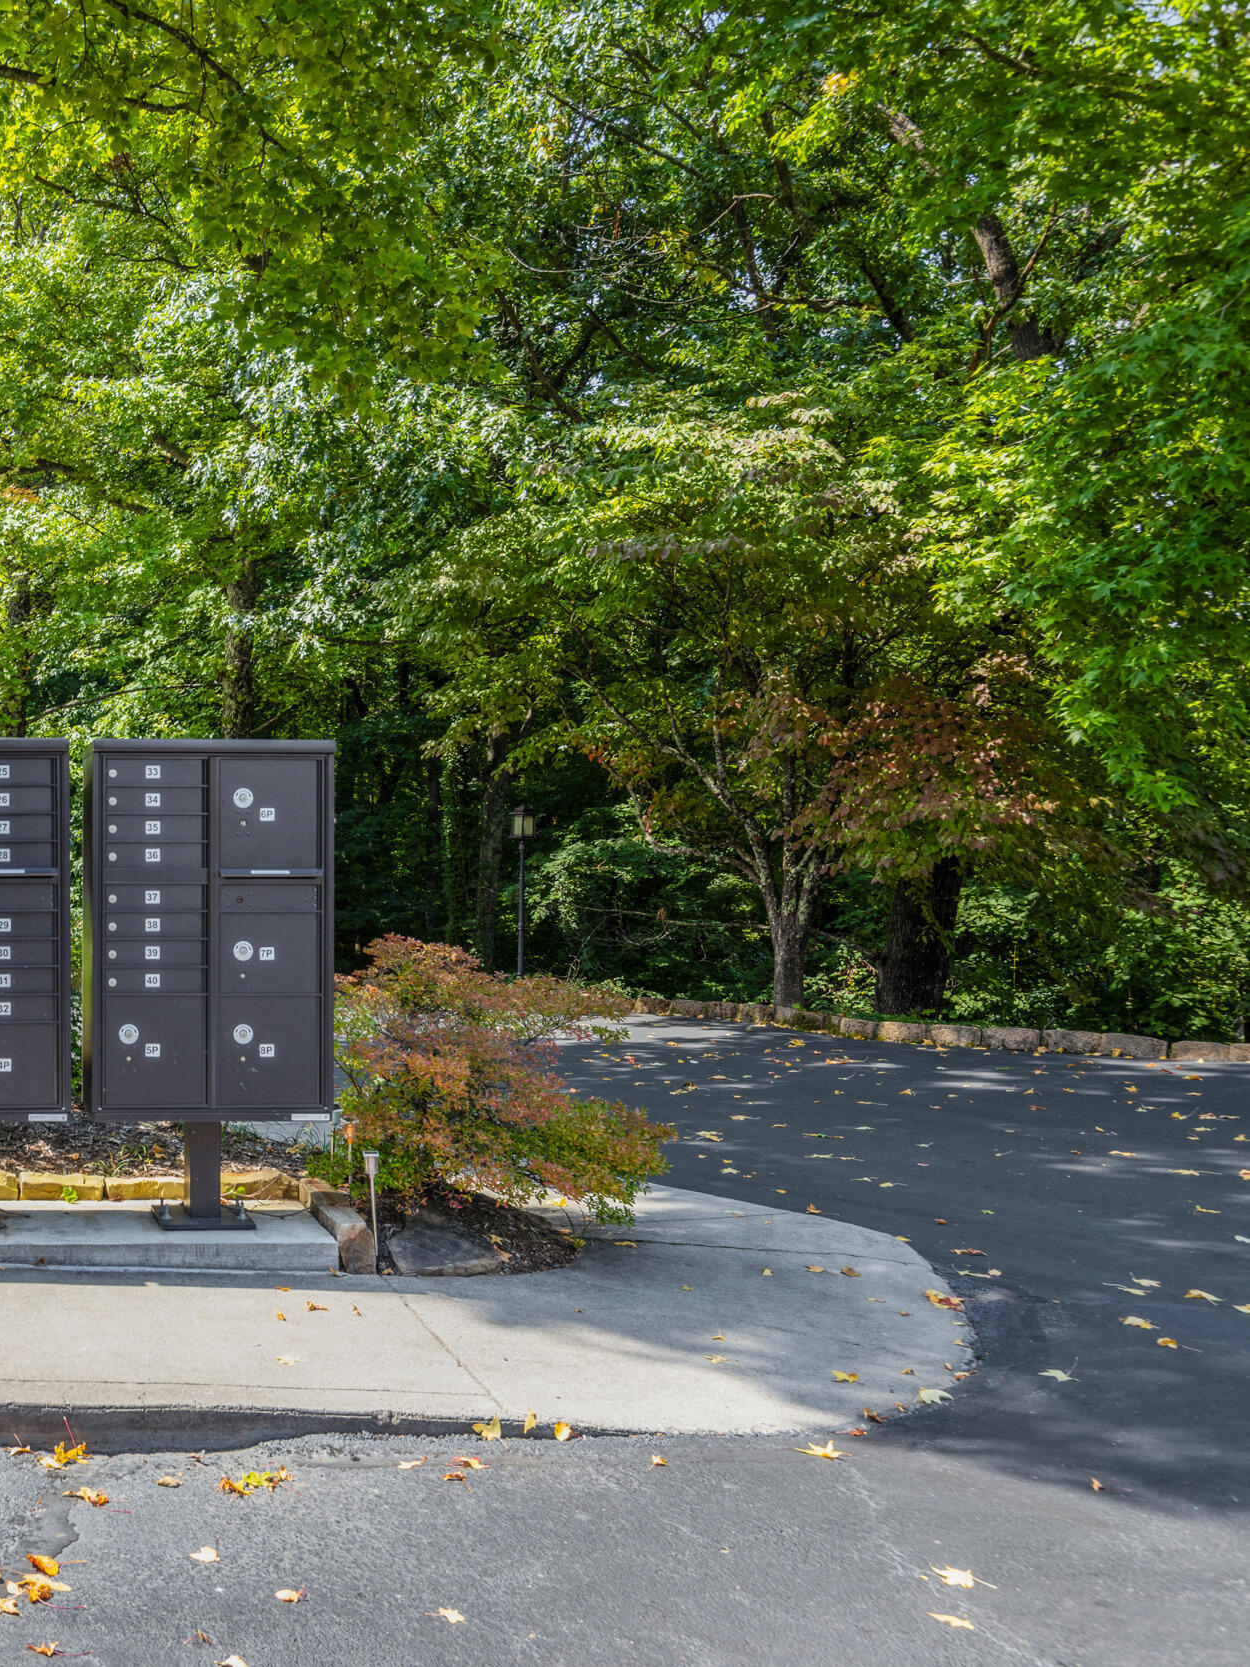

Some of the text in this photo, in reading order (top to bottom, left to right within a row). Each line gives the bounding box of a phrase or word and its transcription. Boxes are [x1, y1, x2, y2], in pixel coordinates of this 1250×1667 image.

[147, 767, 159, 776] 33
[147, 795, 158, 804] 34
[260, 810, 273, 819] 6P
[147, 823, 159, 832] 35
[147, 850, 159, 860] 36
[146, 892, 158, 902] 37
[146, 920, 158, 929] 38
[146, 948, 158, 957] 39
[260, 949, 273, 958] 7P
[146, 976, 158, 985] 40
[146, 1045, 159, 1055] 5P
[260, 1046, 273, 1055] 8P
